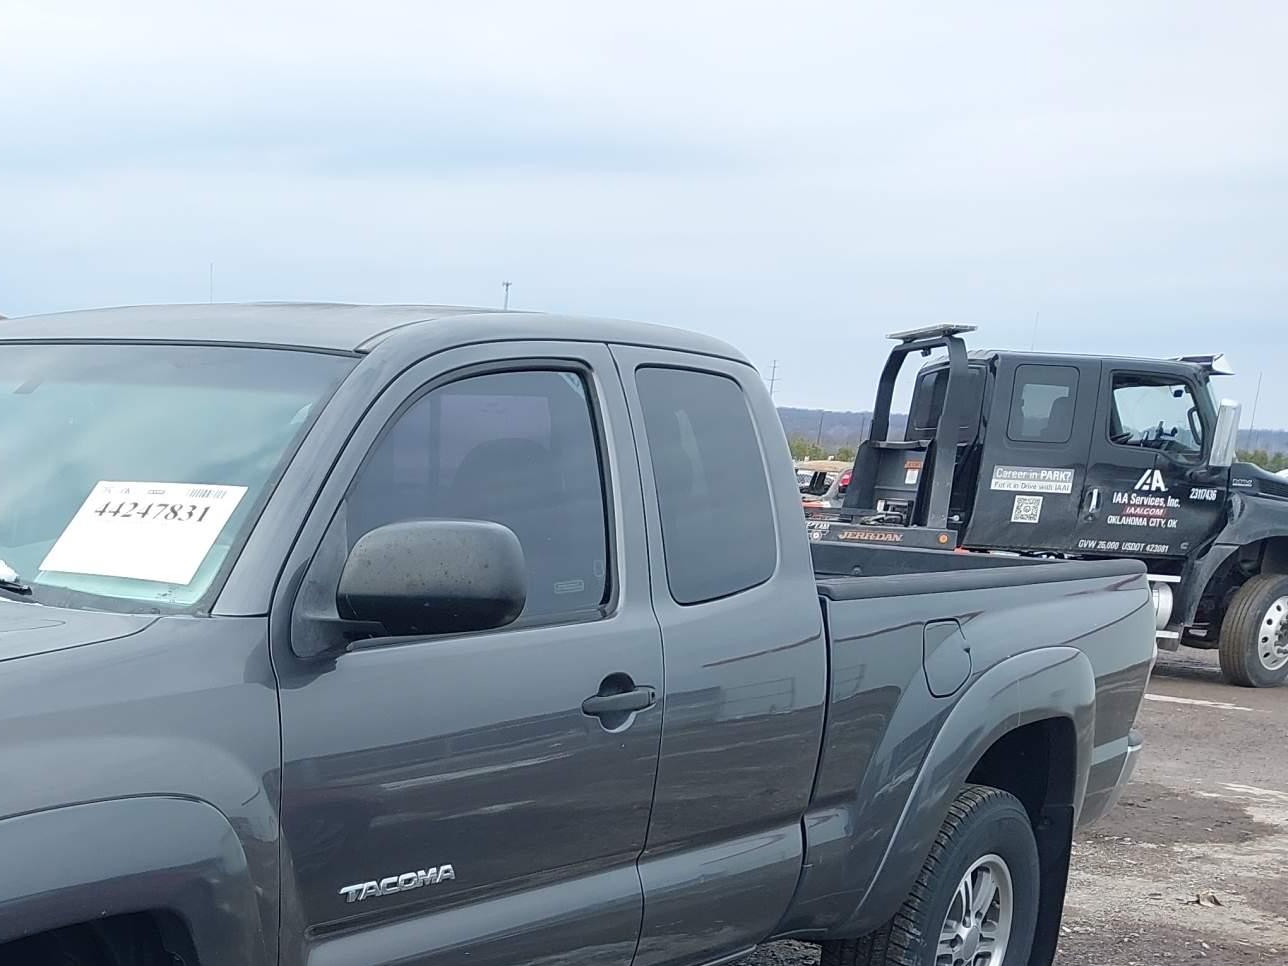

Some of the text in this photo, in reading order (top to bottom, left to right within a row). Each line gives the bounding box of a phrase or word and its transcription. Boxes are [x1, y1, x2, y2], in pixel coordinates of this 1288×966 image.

[995, 468, 1072, 481] Career in PARK?
[1021, 482, 1037, 490] Drive
[1112, 491, 1181, 508] IAA Services, Inc.
[94, 501, 211, 522] 44247831
[1107, 515, 1178, 528] OKLAHOMA CITY, OK
[1078, 539, 1097, 548] GVW
[1121, 541, 1145, 552] USDOT
[339, 864, 455, 903] TACOMA
